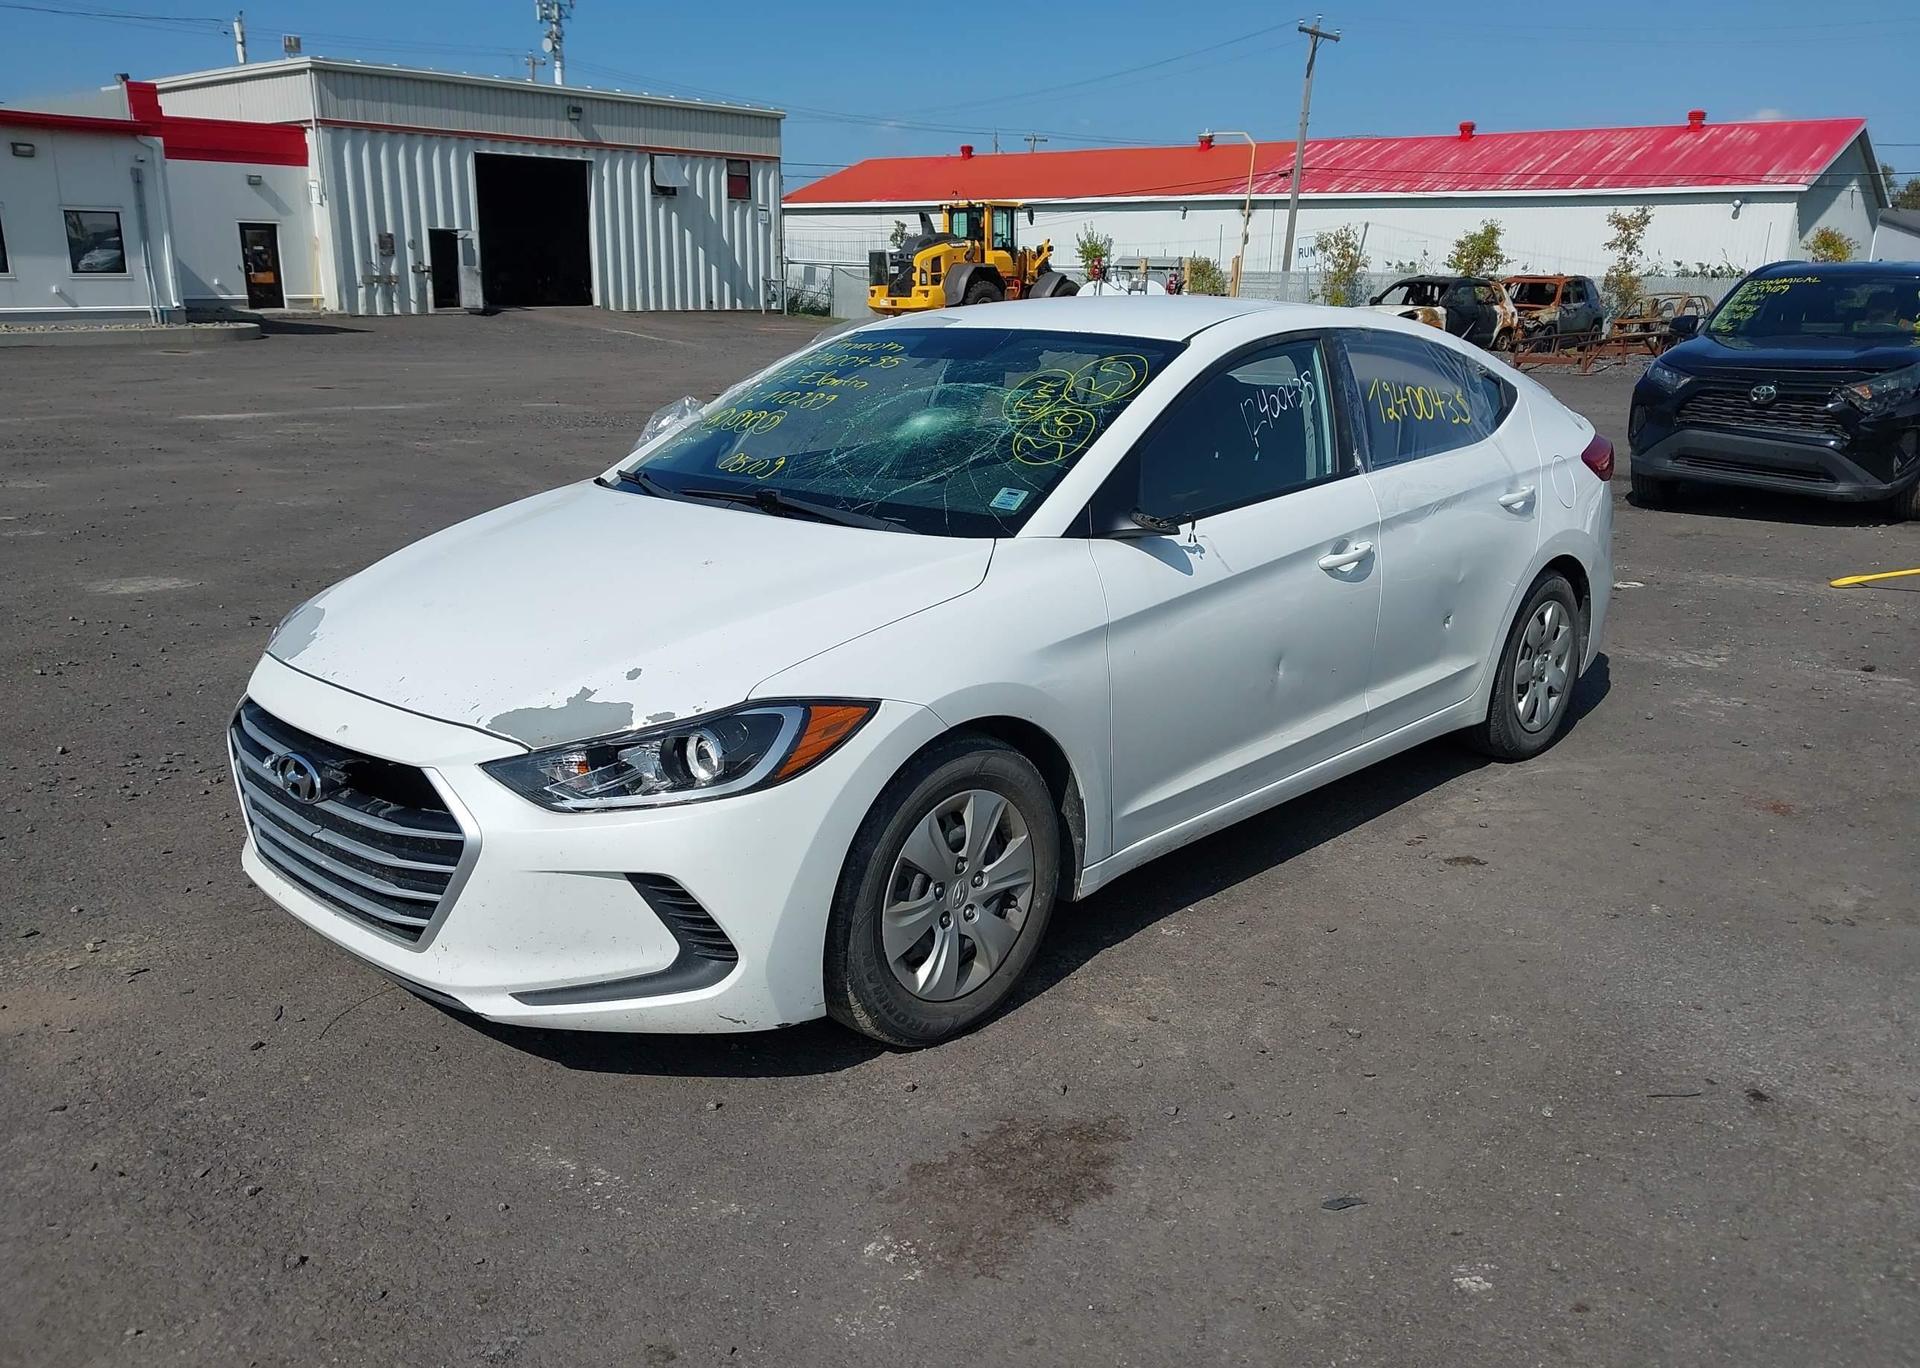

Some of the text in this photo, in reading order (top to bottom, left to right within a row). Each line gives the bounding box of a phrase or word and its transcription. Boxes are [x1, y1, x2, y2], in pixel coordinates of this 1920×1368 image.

[1298, 246, 1316, 259] RUN
[1240, 370, 1315, 449] 12400435
[1368, 378, 1472, 425] 12400435
